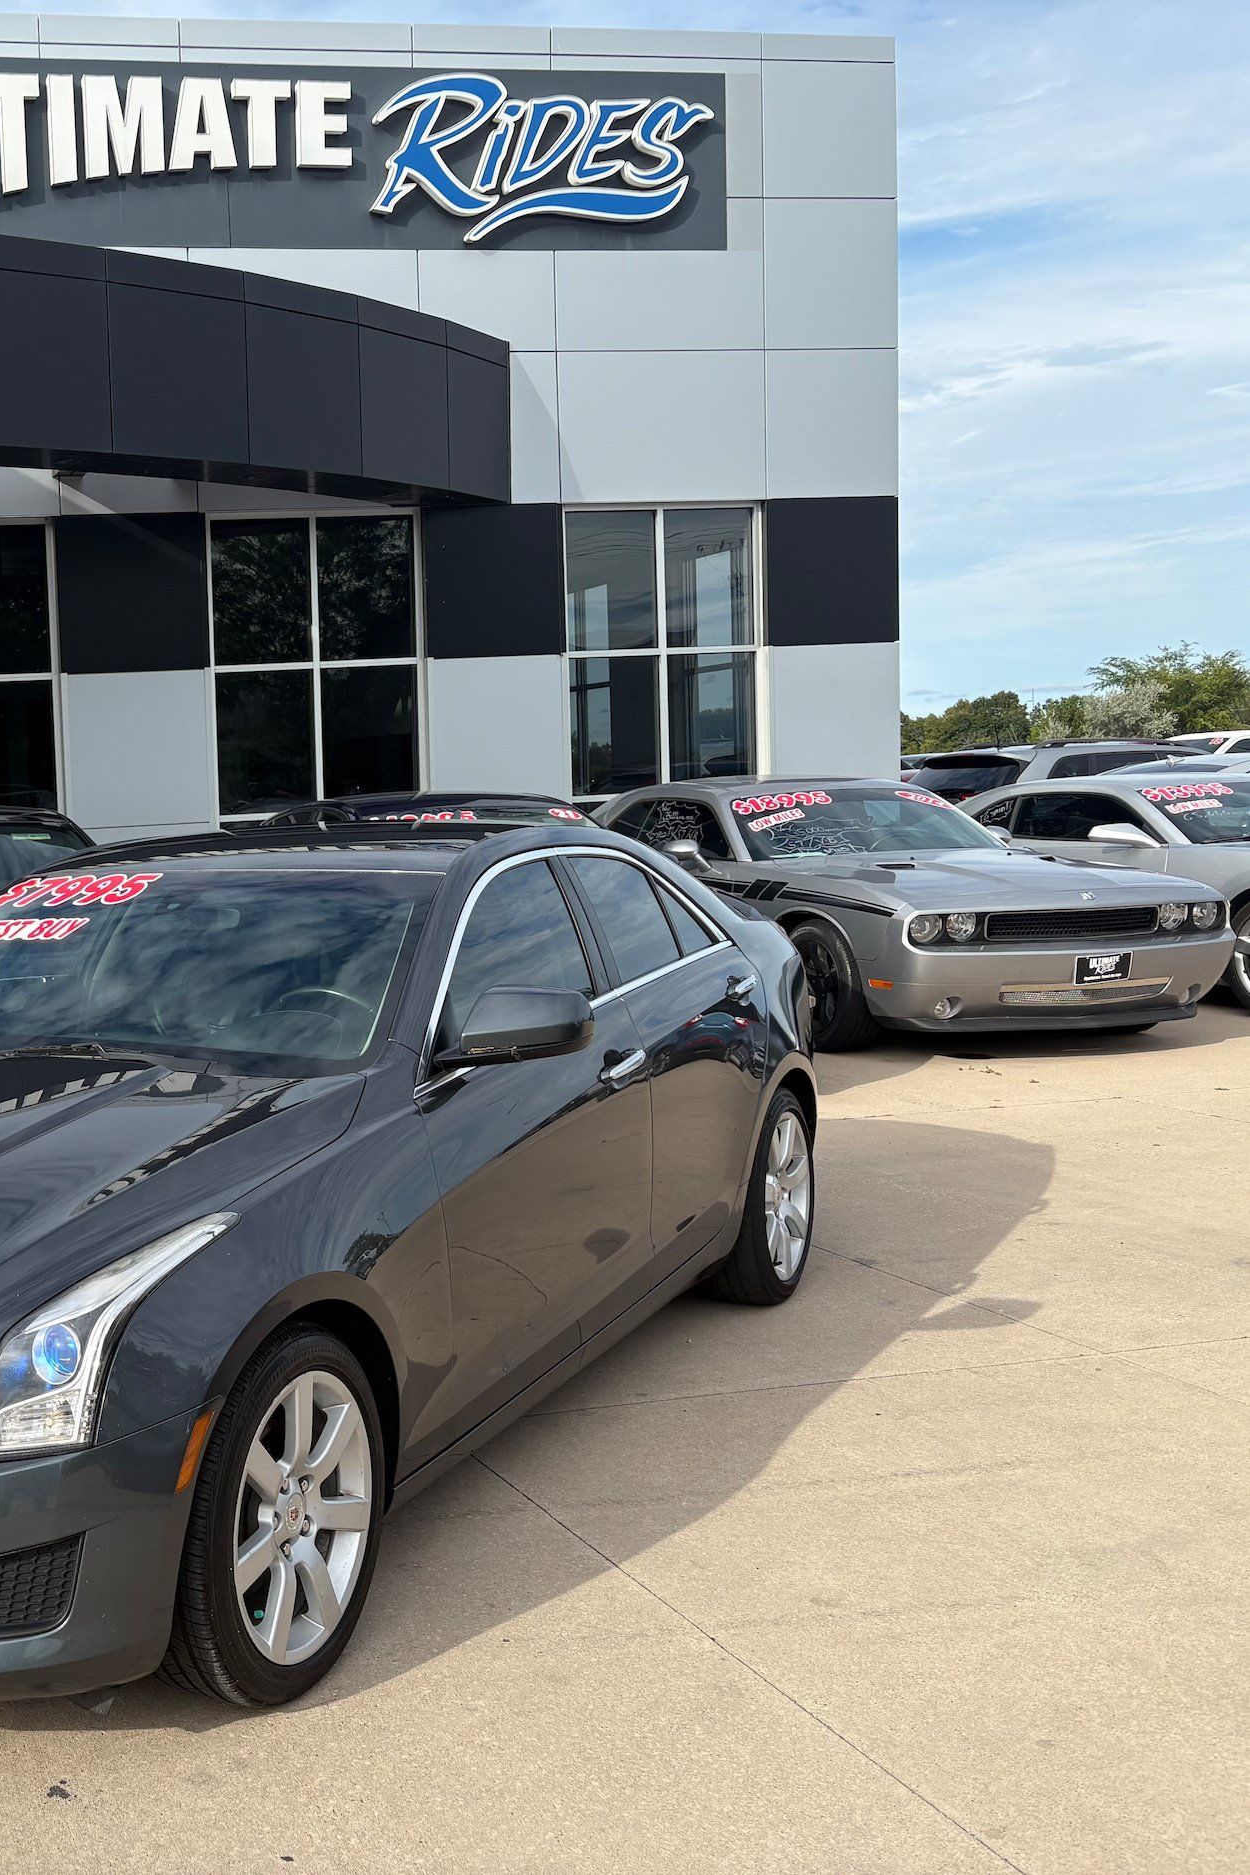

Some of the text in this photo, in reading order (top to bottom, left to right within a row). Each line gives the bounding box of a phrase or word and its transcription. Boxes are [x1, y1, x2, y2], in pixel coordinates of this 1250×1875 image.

[732, 789, 832, 815] $18995
[749, 818, 773, 832] LOW
[774, 808, 805, 822] MILES
[27, 918, 90, 940] BUY
